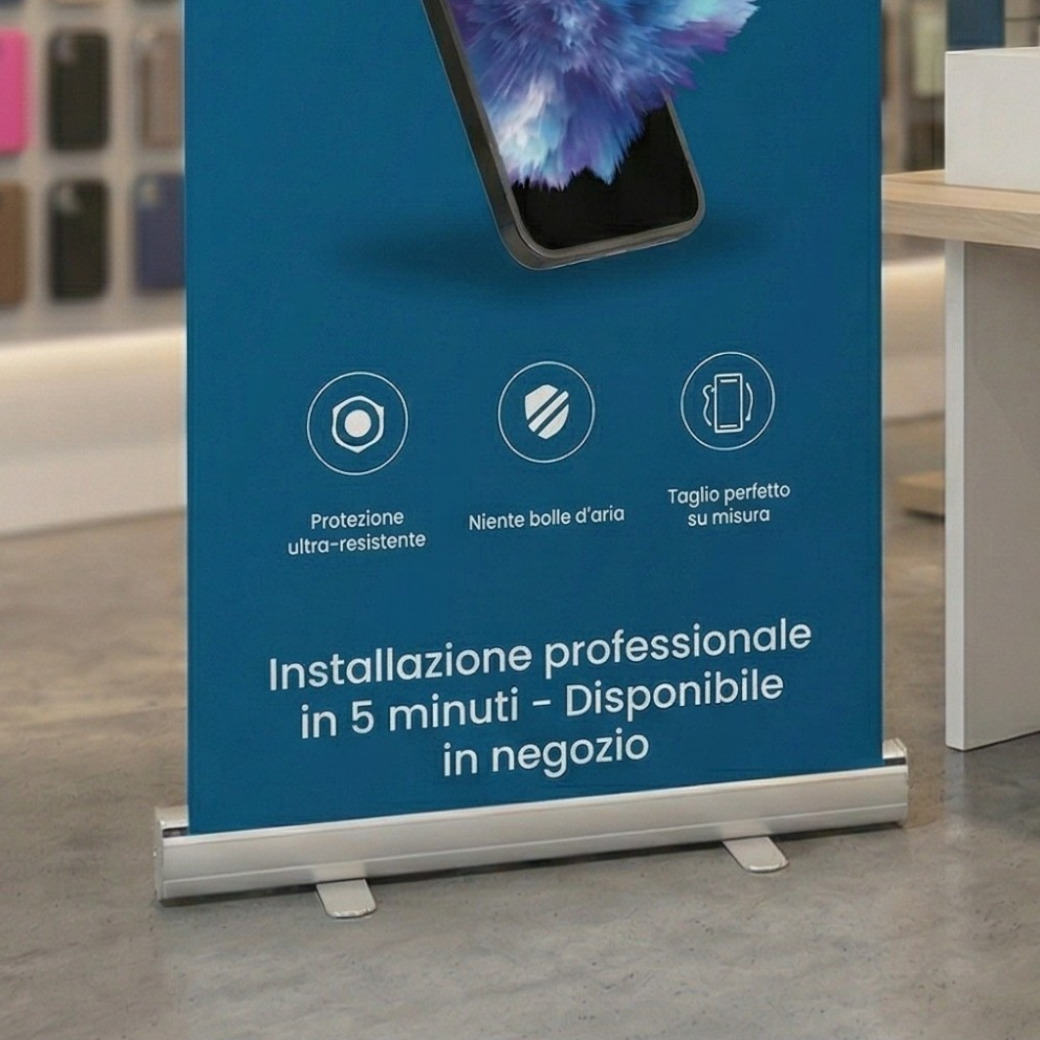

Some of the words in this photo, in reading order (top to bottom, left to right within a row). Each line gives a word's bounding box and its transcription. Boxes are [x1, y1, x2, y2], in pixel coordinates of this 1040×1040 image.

[666, 485, 721, 509] Taglio
[723, 481, 791, 506] perfetto
[310, 508, 404, 530] Protezione
[468, 512, 526, 531] Niente
[529, 507, 572, 527] bolle
[574, 505, 625, 525] d'aria
[687, 513, 708, 527] su
[711, 506, 770, 525] misura
[287, 532, 426, 556] ultra-resistente
[269, 642, 533, 692] Installazione
[544, 617, 813, 680] professionale
[300, 704, 337, 739] in
[351, 700, 375, 734] 5
[388, 686, 519, 732] minuti
[565, 668, 784, 722] Disponibile
[443, 742, 478, 777] in
[492, 727, 649, 778] negozio
